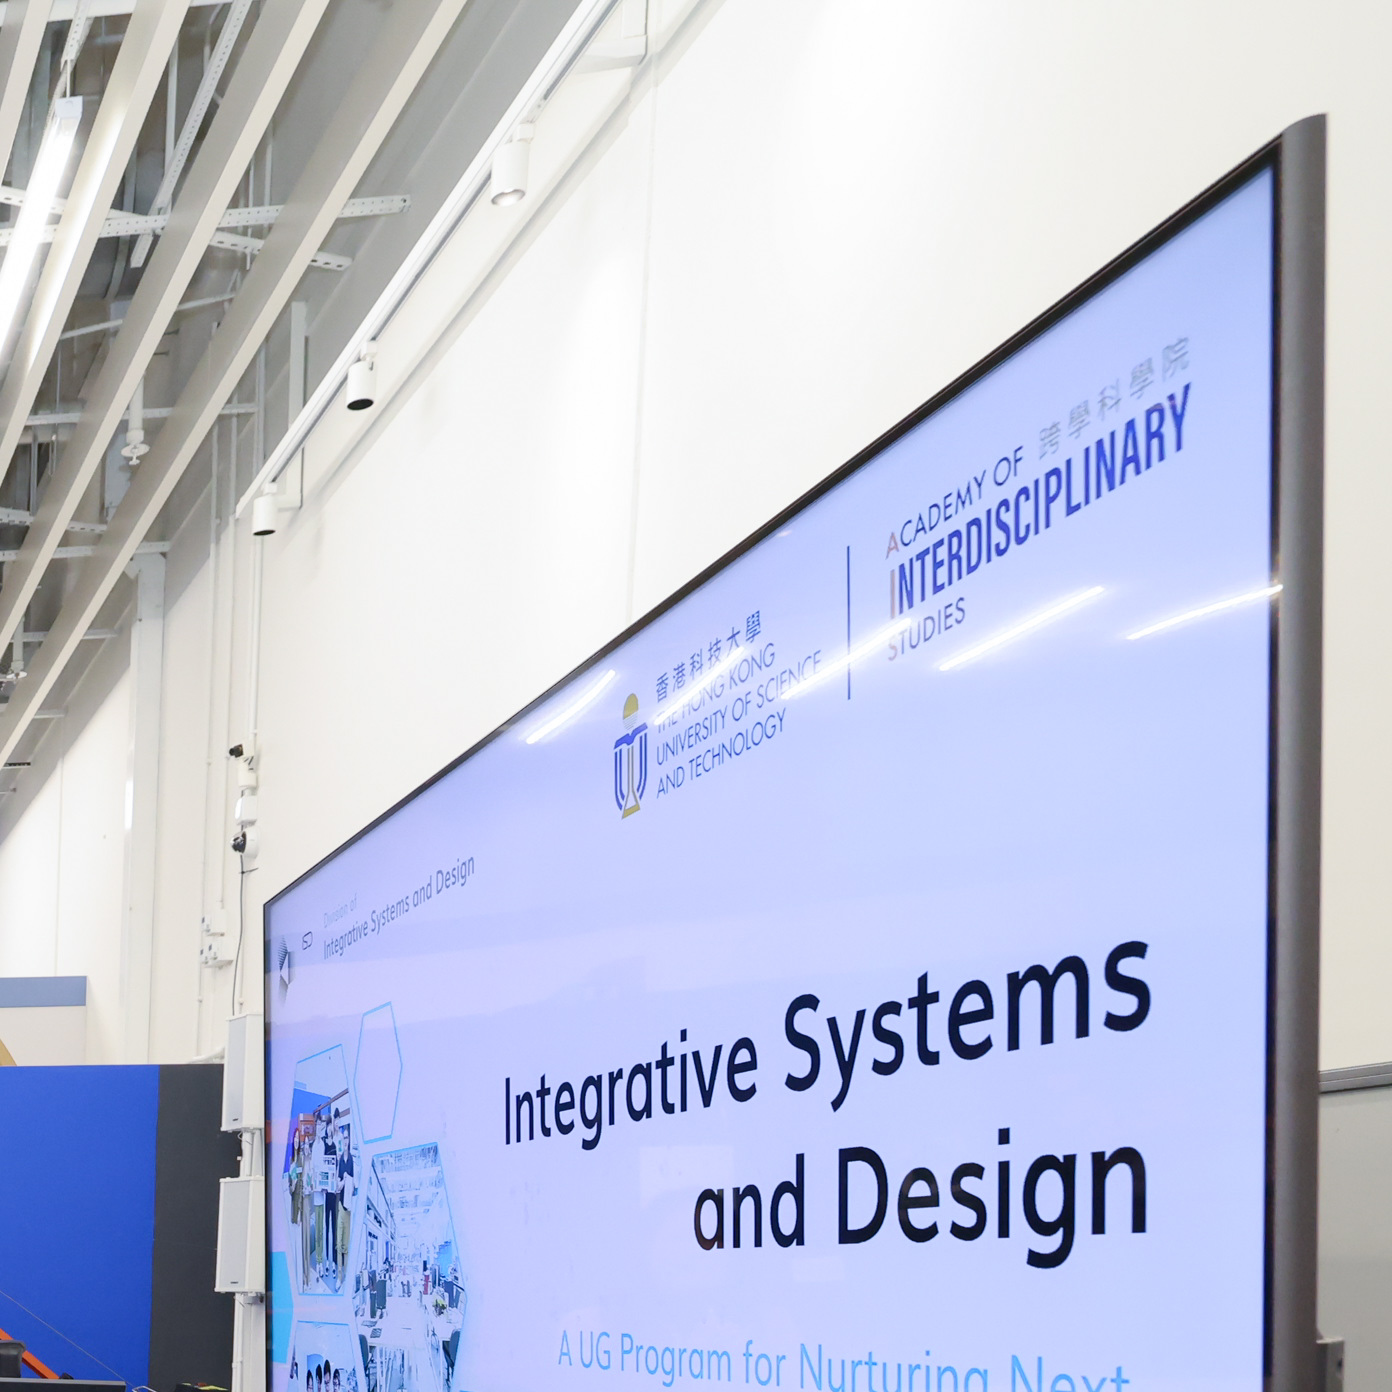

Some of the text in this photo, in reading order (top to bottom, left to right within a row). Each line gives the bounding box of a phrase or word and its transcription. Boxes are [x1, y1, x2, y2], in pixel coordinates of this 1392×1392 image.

[885, 445, 1024, 560] ACADEMY OF
[889, 381, 1192, 619] INTERDISCIPLINARY
[656, 610, 762, 703] 香港科技大學
[729, 642, 776, 692] KONG
[887, 597, 966, 661] STUDIES
[656, 707, 787, 799] AND TECHNOLOGY
[657, 649, 822, 765] UNIVERSITY OF SCIENCE
[323, 856, 476, 960] Integrative Systems and Design
[324, 902, 349, 928] Division
[504, 940, 1151, 1150] Integrative Systems
[693, 1127, 1148, 1269] and Design
[558, 1329, 573, 1368] A
[579, 1330, 612, 1371] UG
[620, 1332, 732, 1387] Program
[743, 1339, 787, 1388] for
